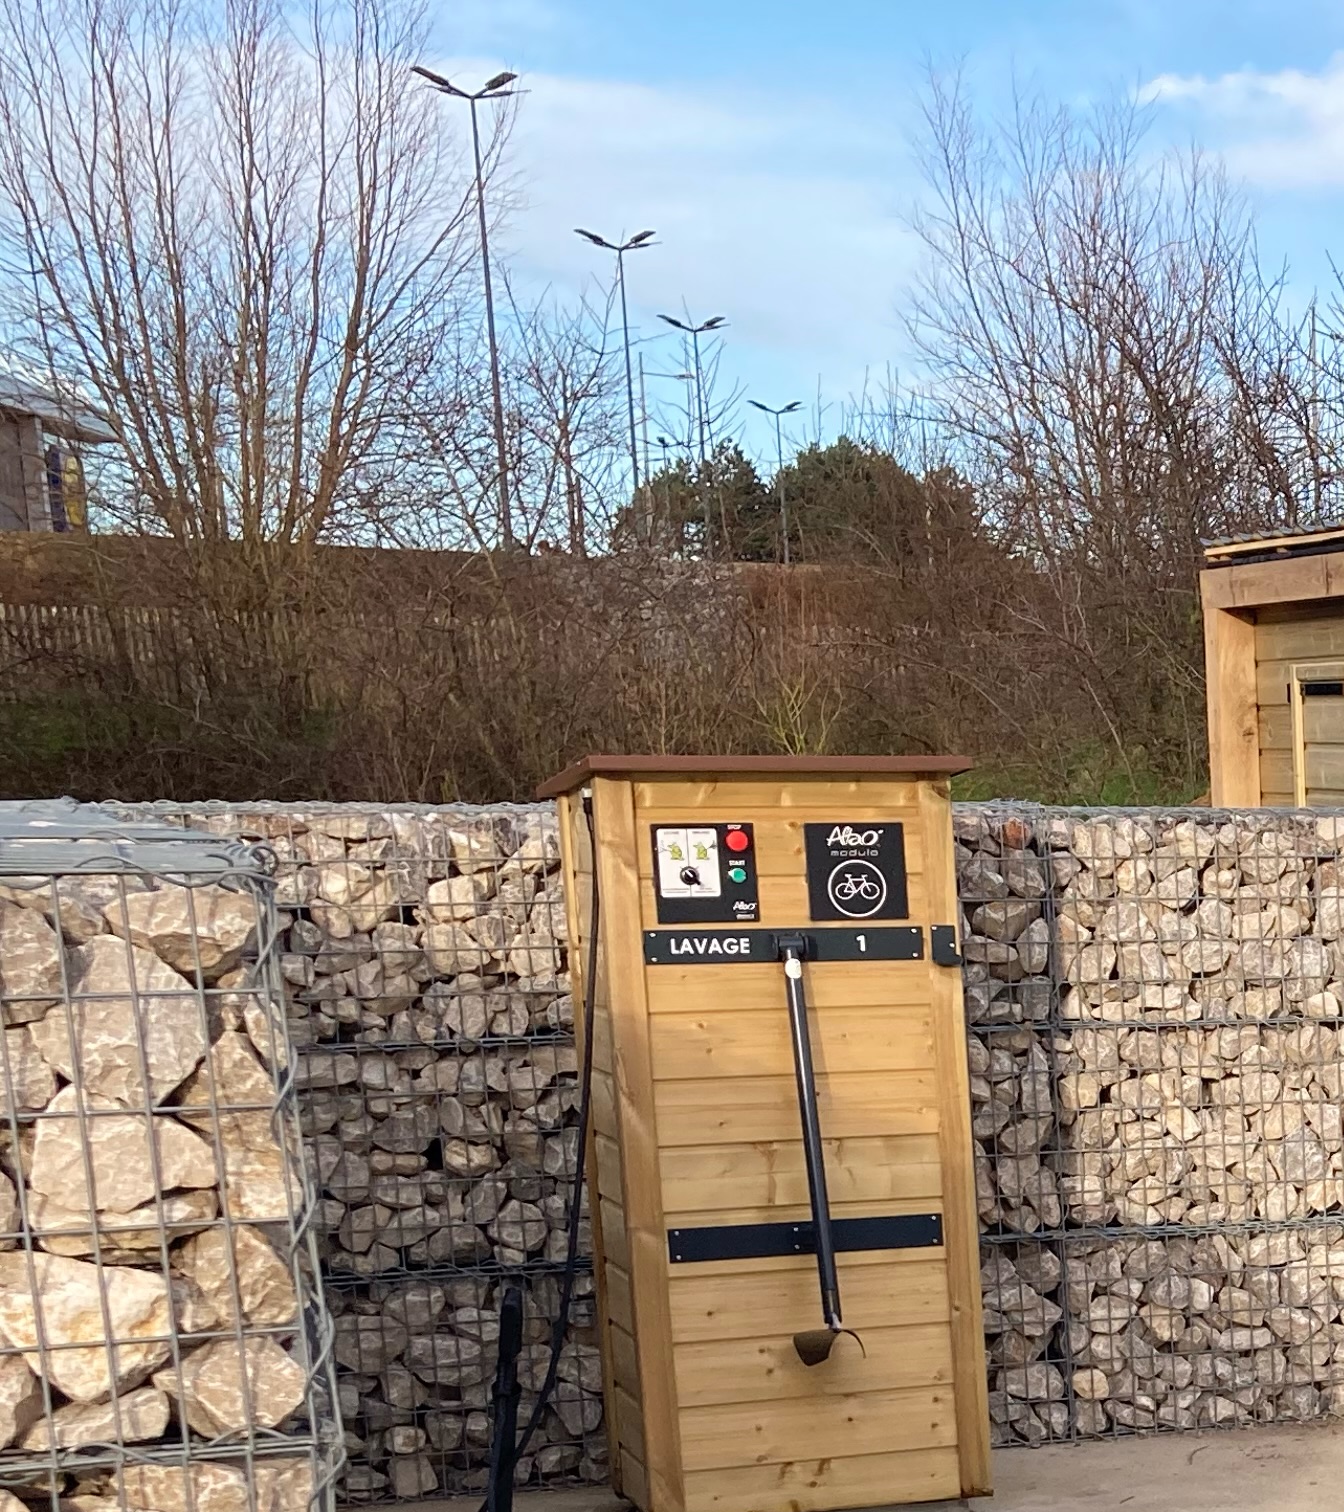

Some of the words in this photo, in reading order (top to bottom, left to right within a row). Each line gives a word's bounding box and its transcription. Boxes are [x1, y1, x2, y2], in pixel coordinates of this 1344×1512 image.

[830, 849, 878, 857] modulo
[670, 937, 750, 955] LAVAGE
[856, 935, 866, 951] 1
